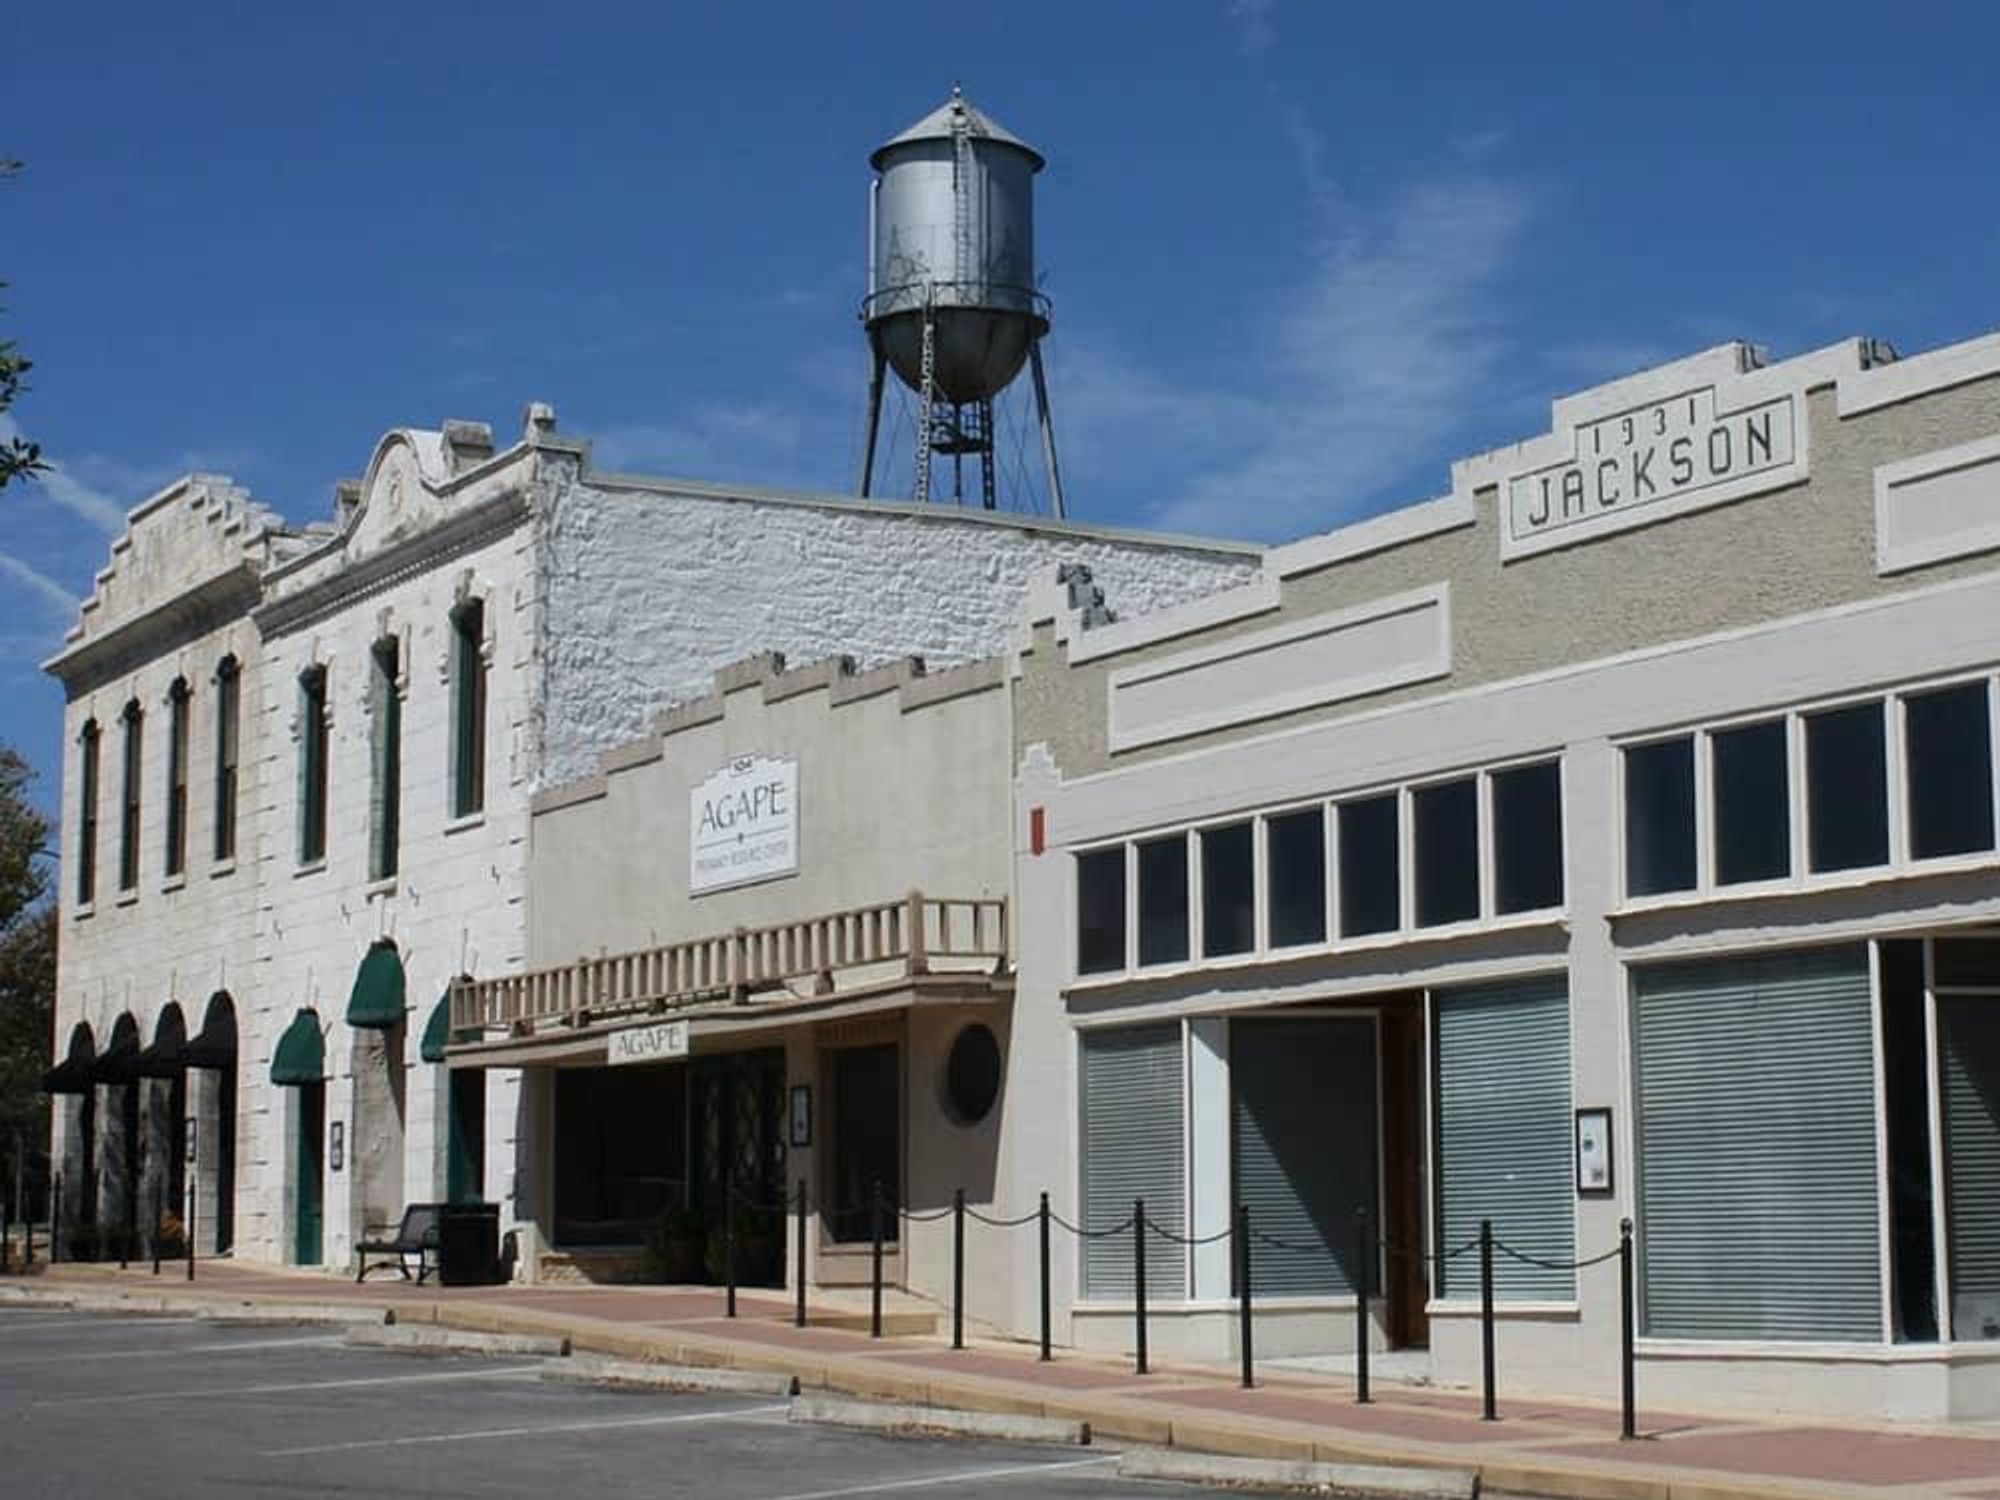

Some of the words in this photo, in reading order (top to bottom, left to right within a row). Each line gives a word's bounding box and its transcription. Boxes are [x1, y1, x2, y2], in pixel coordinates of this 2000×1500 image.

[1594, 398, 1695, 454] 1931
[1528, 412, 1772, 526] JACKSON
[697, 781, 788, 834] AGAPE
[617, 1025, 683, 1056] AGAPE
